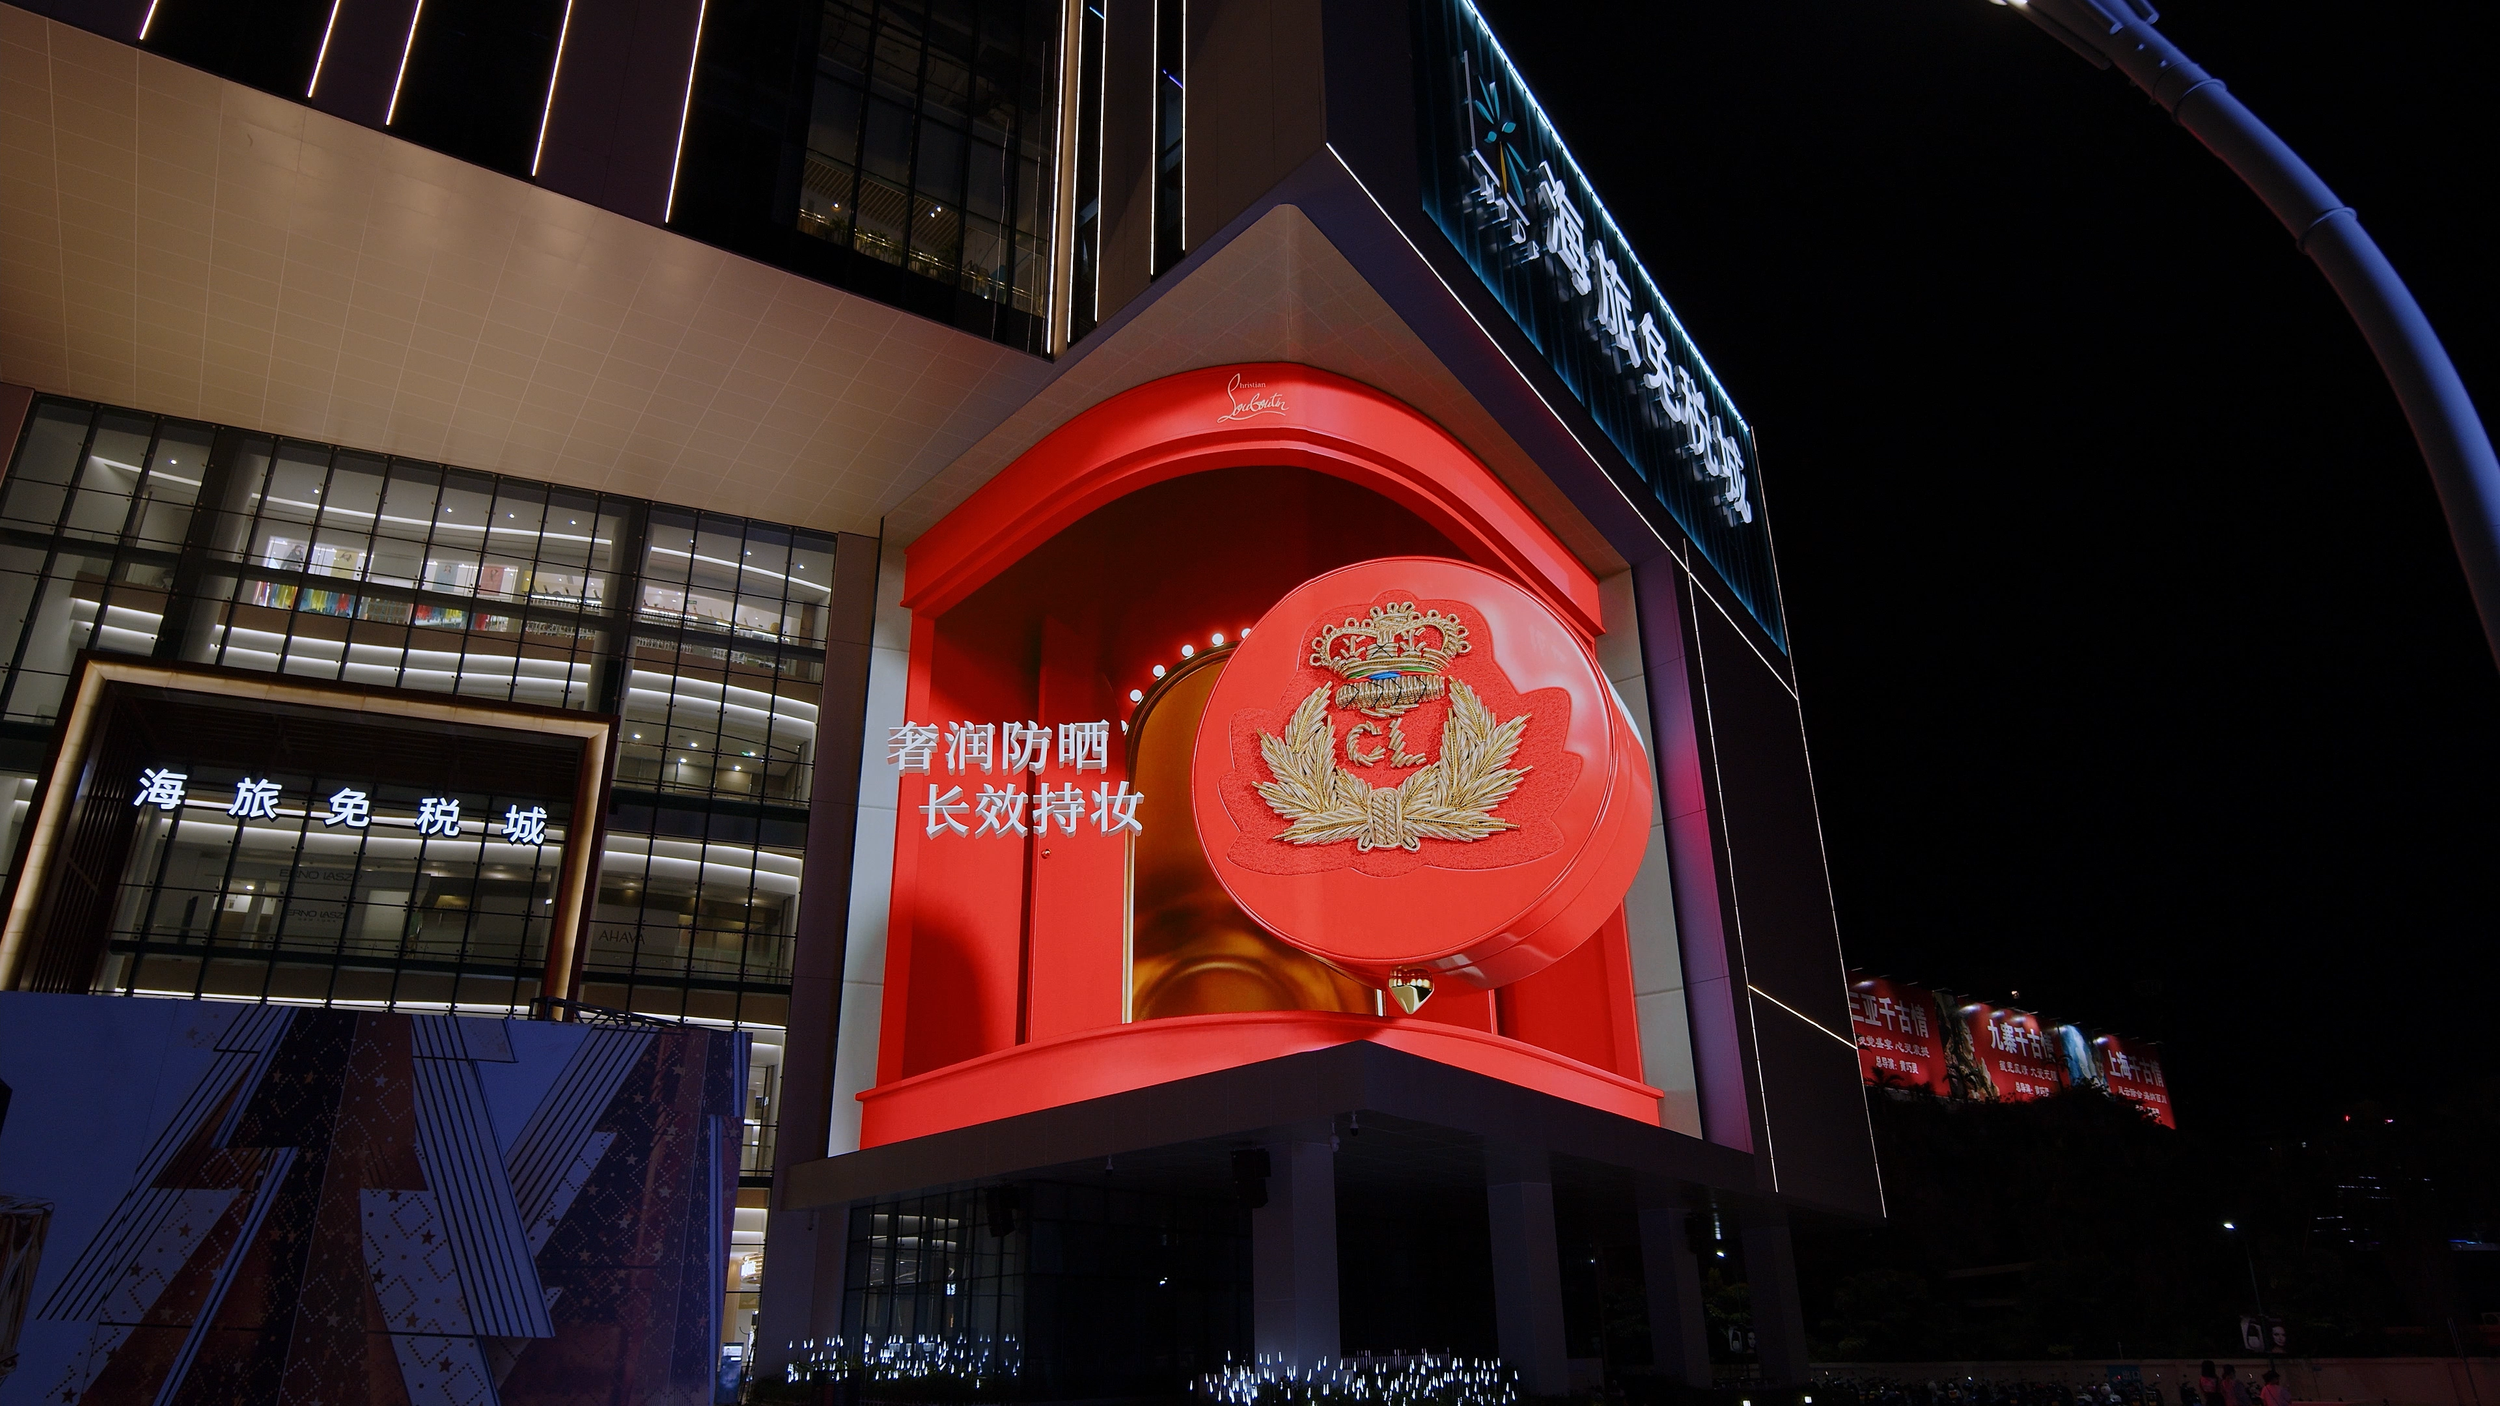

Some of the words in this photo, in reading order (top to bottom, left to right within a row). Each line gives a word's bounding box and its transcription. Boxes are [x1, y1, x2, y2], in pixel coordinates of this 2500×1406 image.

[1538, 161, 1752, 524] 海旅免税城
[1216, 373, 1289, 423] Louboutin
[887, 719, 1110, 776] 奢润防晒
[1346, 718, 1426, 768] CL
[134, 768, 548, 845] 海旅免税城
[919, 780, 1144, 839] 长效持妆
[279, 868, 320, 880] ENO
[598, 930, 645, 945] AHAVA
[1849, 991, 1929, 1038] 三亚千古情
[1987, 1019, 2056, 1063] 九寨千古情
[2107, 1049, 2165, 1088] 上海千古情
